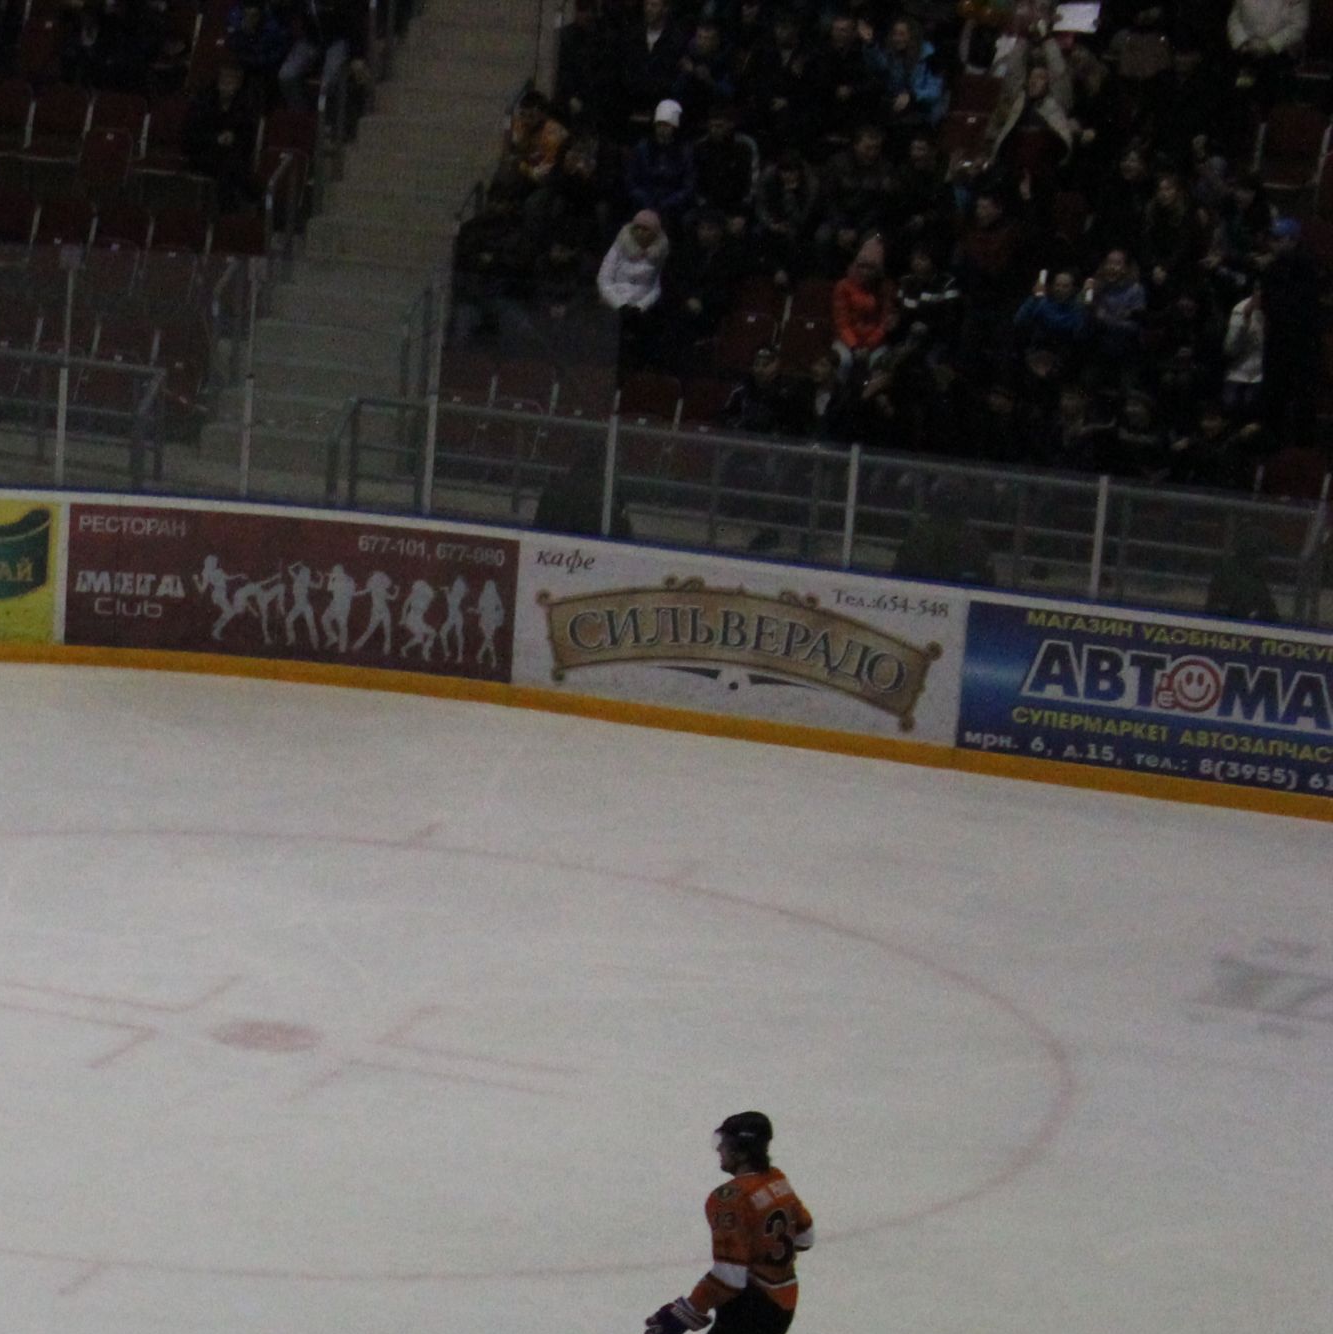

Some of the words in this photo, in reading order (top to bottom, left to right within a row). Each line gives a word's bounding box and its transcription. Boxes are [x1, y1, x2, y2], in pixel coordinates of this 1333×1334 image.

[78, 514, 187, 538] РЕСТОРАН
[75, 569, 186, 599] МЕГА
[94, 598, 162, 619] Club
[1026, 610, 1133, 638] МАГАЗИН
[1141, 624, 1252, 652] УДОБНЫХ
[568, 605, 907, 694] СИЛЬВЕРАДО
[1011, 706, 1169, 742] СУПЕРМАРКЕТ
[1199, 758, 1298, 790] 8(3955)
